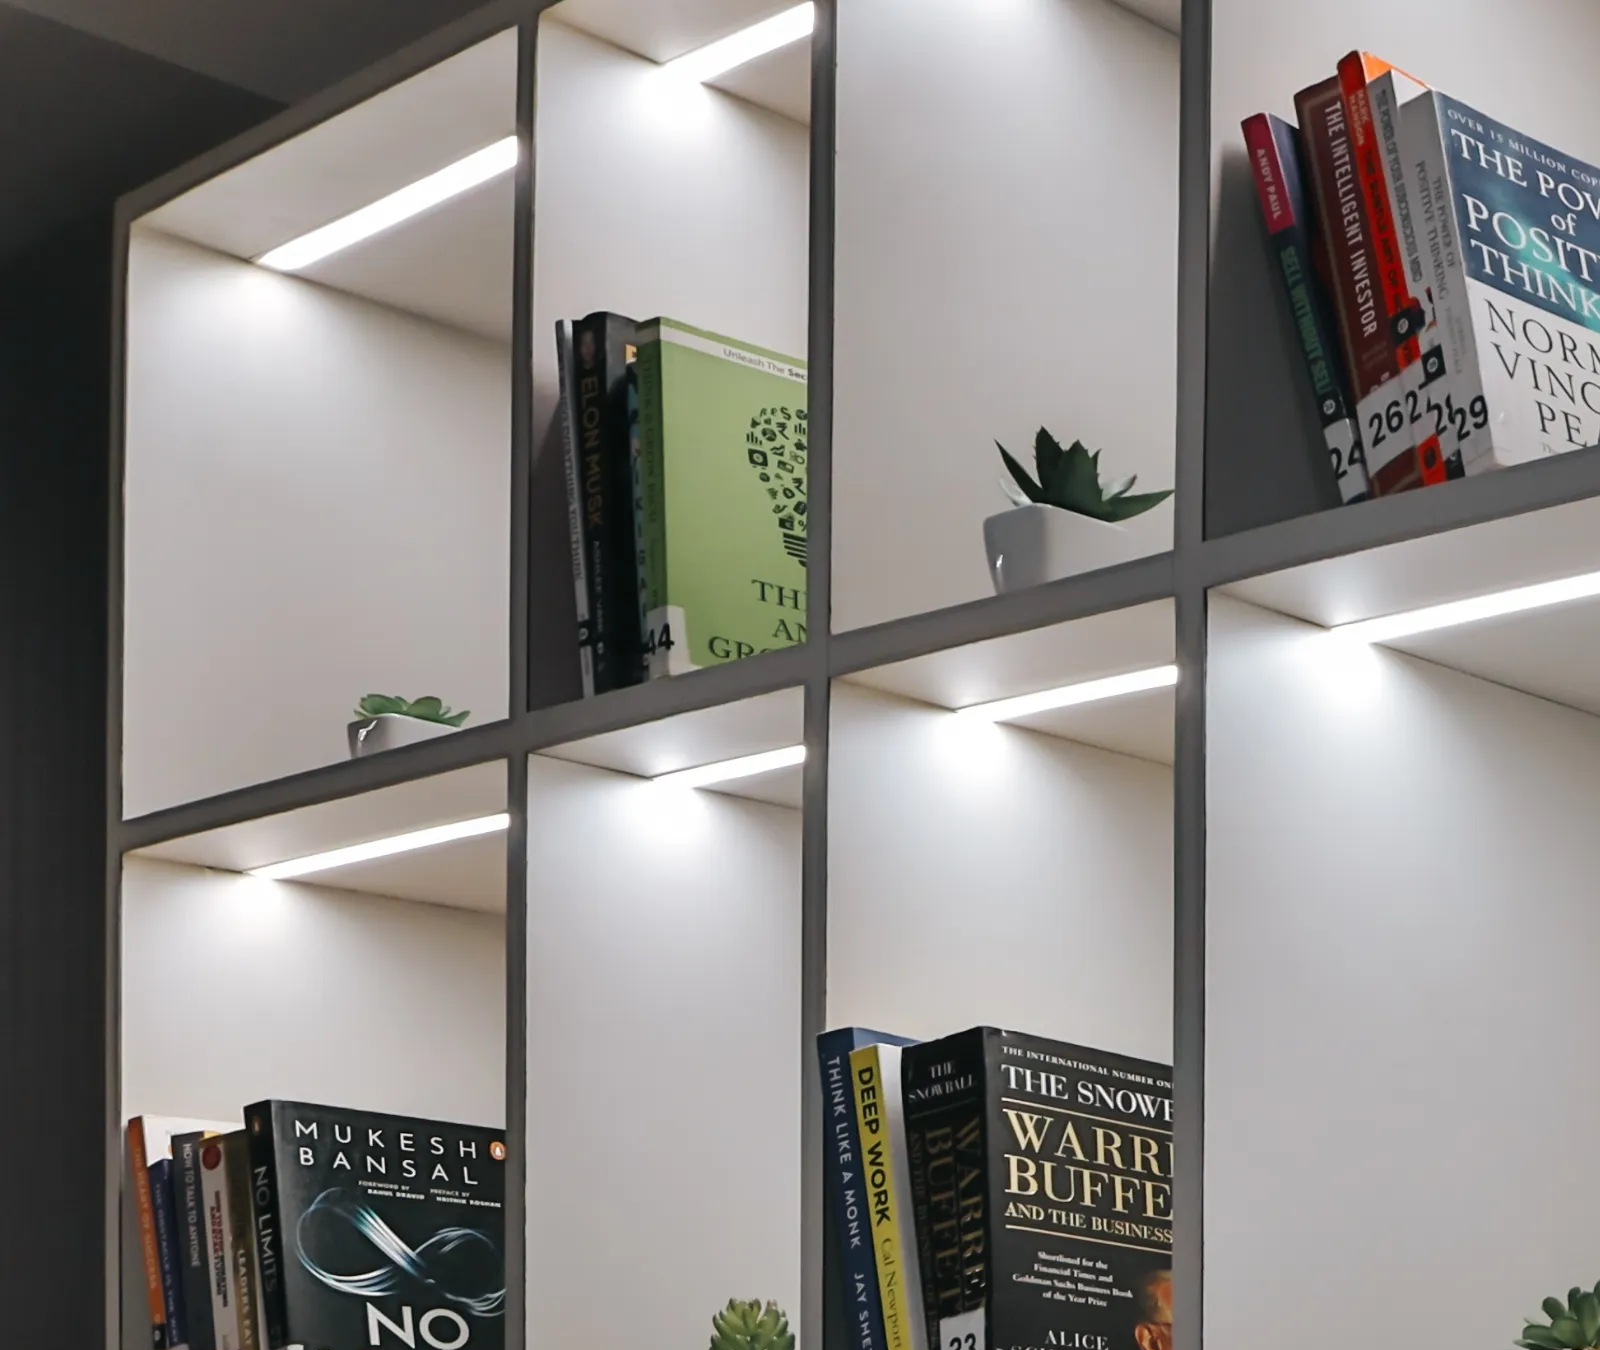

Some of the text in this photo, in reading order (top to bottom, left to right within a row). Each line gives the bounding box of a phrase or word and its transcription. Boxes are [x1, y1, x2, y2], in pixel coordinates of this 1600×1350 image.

[1447, 108, 1485, 134] OVER
[1490, 131, 1504, 145] 15
[1508, 138, 1567, 174] MILLION
[1450, 127, 1528, 188] THE
[1255, 147, 1281, 219] ANDY PAUL
[1322, 99, 1380, 337] THE INTELLIGENT INVESTOR
[1550, 211, 1577, 236] of
[722, 348, 786, 374] Unleash The
[1454, 394, 1489, 442] 29
[581, 376, 602, 528] ELON MUSK
[825, 1056, 847, 1116] THINK
[1002, 1046, 1174, 1089] THE INTERNATIONAL NUMBER ON
[295, 1119, 477, 1159] MUKESH
[833, 1122, 853, 1165] LIKE
[299, 1147, 478, 1185] BANSAL
[358, 1180, 399, 1191] FOREWORD
[841, 1170, 854, 1183] A
[181, 1142, 202, 1266] HOW TO TALK TO ANYONE
[252, 1165, 280, 1290] NO LIMITS
[841, 1189, 862, 1249] MONK
[857, 1066, 904, 1349] DEEP WORK Cal Newport
[1005, 1201, 1174, 1243] AND THE BUSINESS
[852, 1271, 867, 1303] JAY
[366, 1301, 470, 1350] NO
